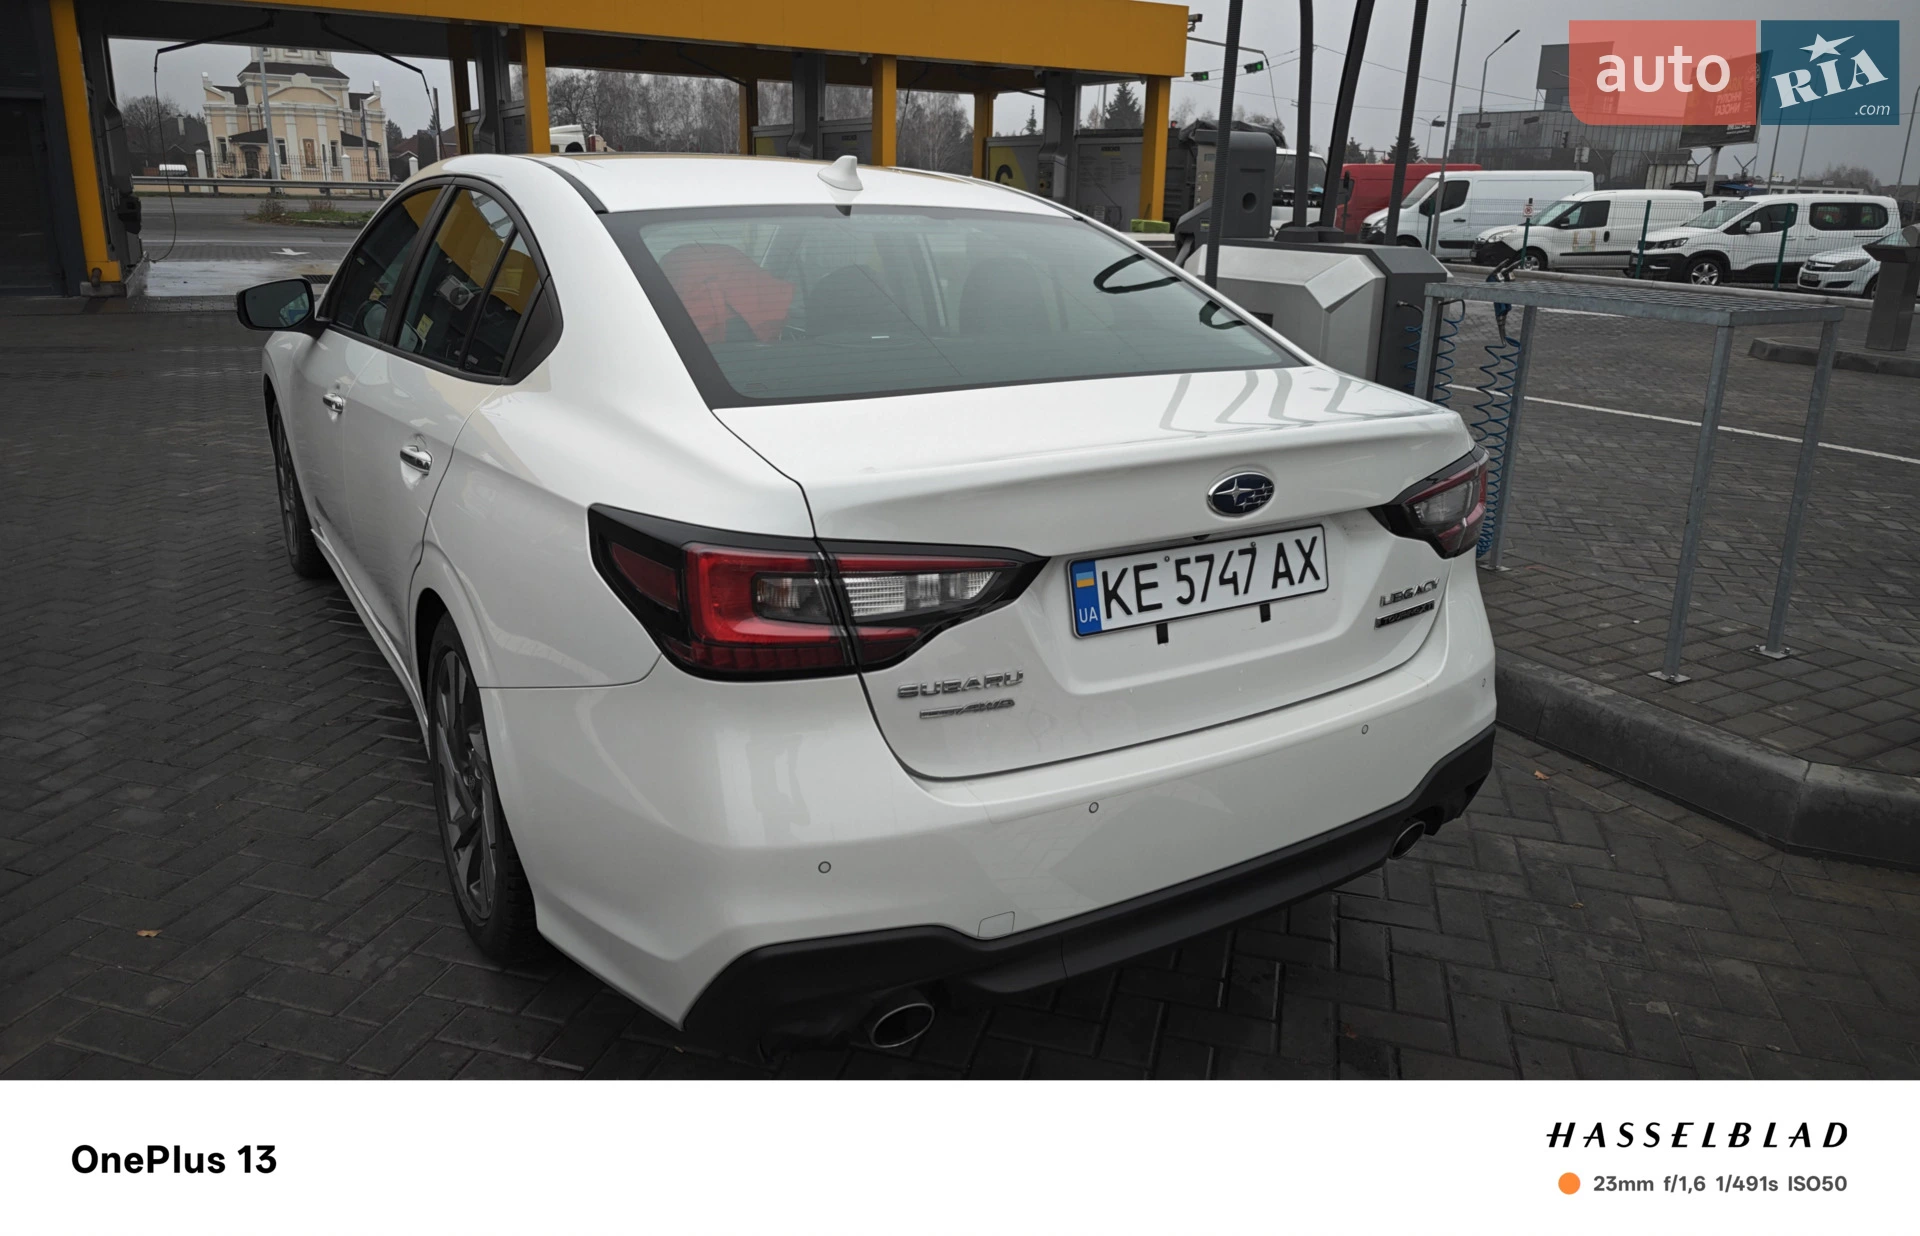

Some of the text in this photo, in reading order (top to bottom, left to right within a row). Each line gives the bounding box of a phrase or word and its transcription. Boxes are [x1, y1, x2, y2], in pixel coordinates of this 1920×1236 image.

[1101, 536, 1320, 619] KE 5747 AX
[1379, 577, 1440, 608] LEGACY
[1079, 605, 1099, 623] UA
[897, 669, 1024, 698] SUBARU
